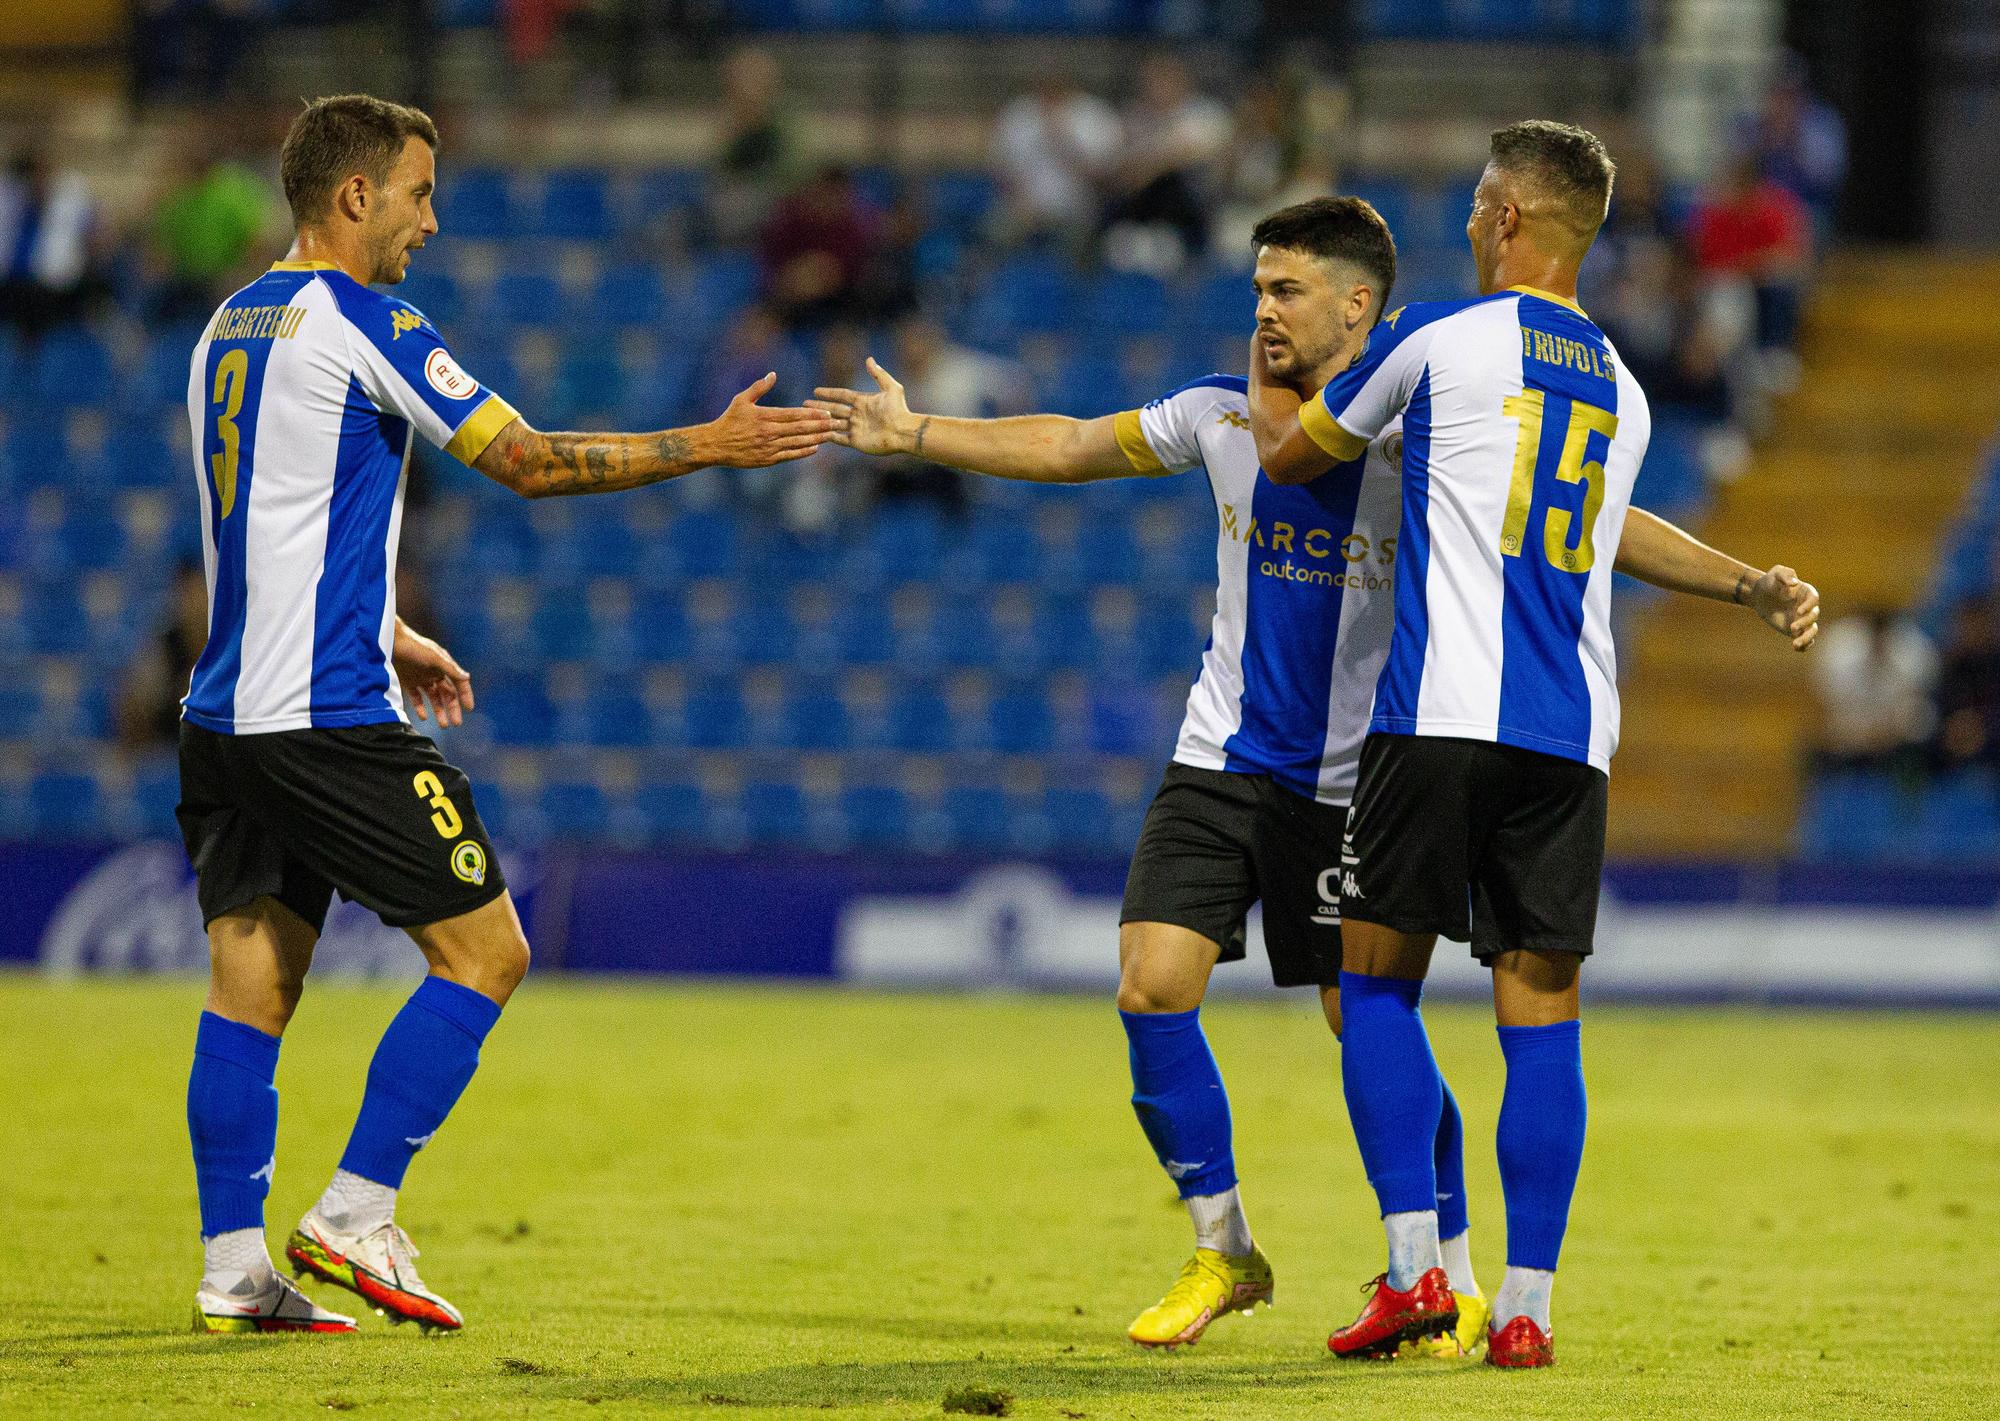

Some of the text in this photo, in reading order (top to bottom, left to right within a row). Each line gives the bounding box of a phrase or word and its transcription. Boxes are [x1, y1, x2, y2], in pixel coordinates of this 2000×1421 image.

[211, 348, 248, 520] 3
[1501, 386, 1620, 574] 15
[1222, 503, 1397, 566] MARCOS
[1260, 559, 1392, 591] automoción
[413, 770, 463, 839] 3
